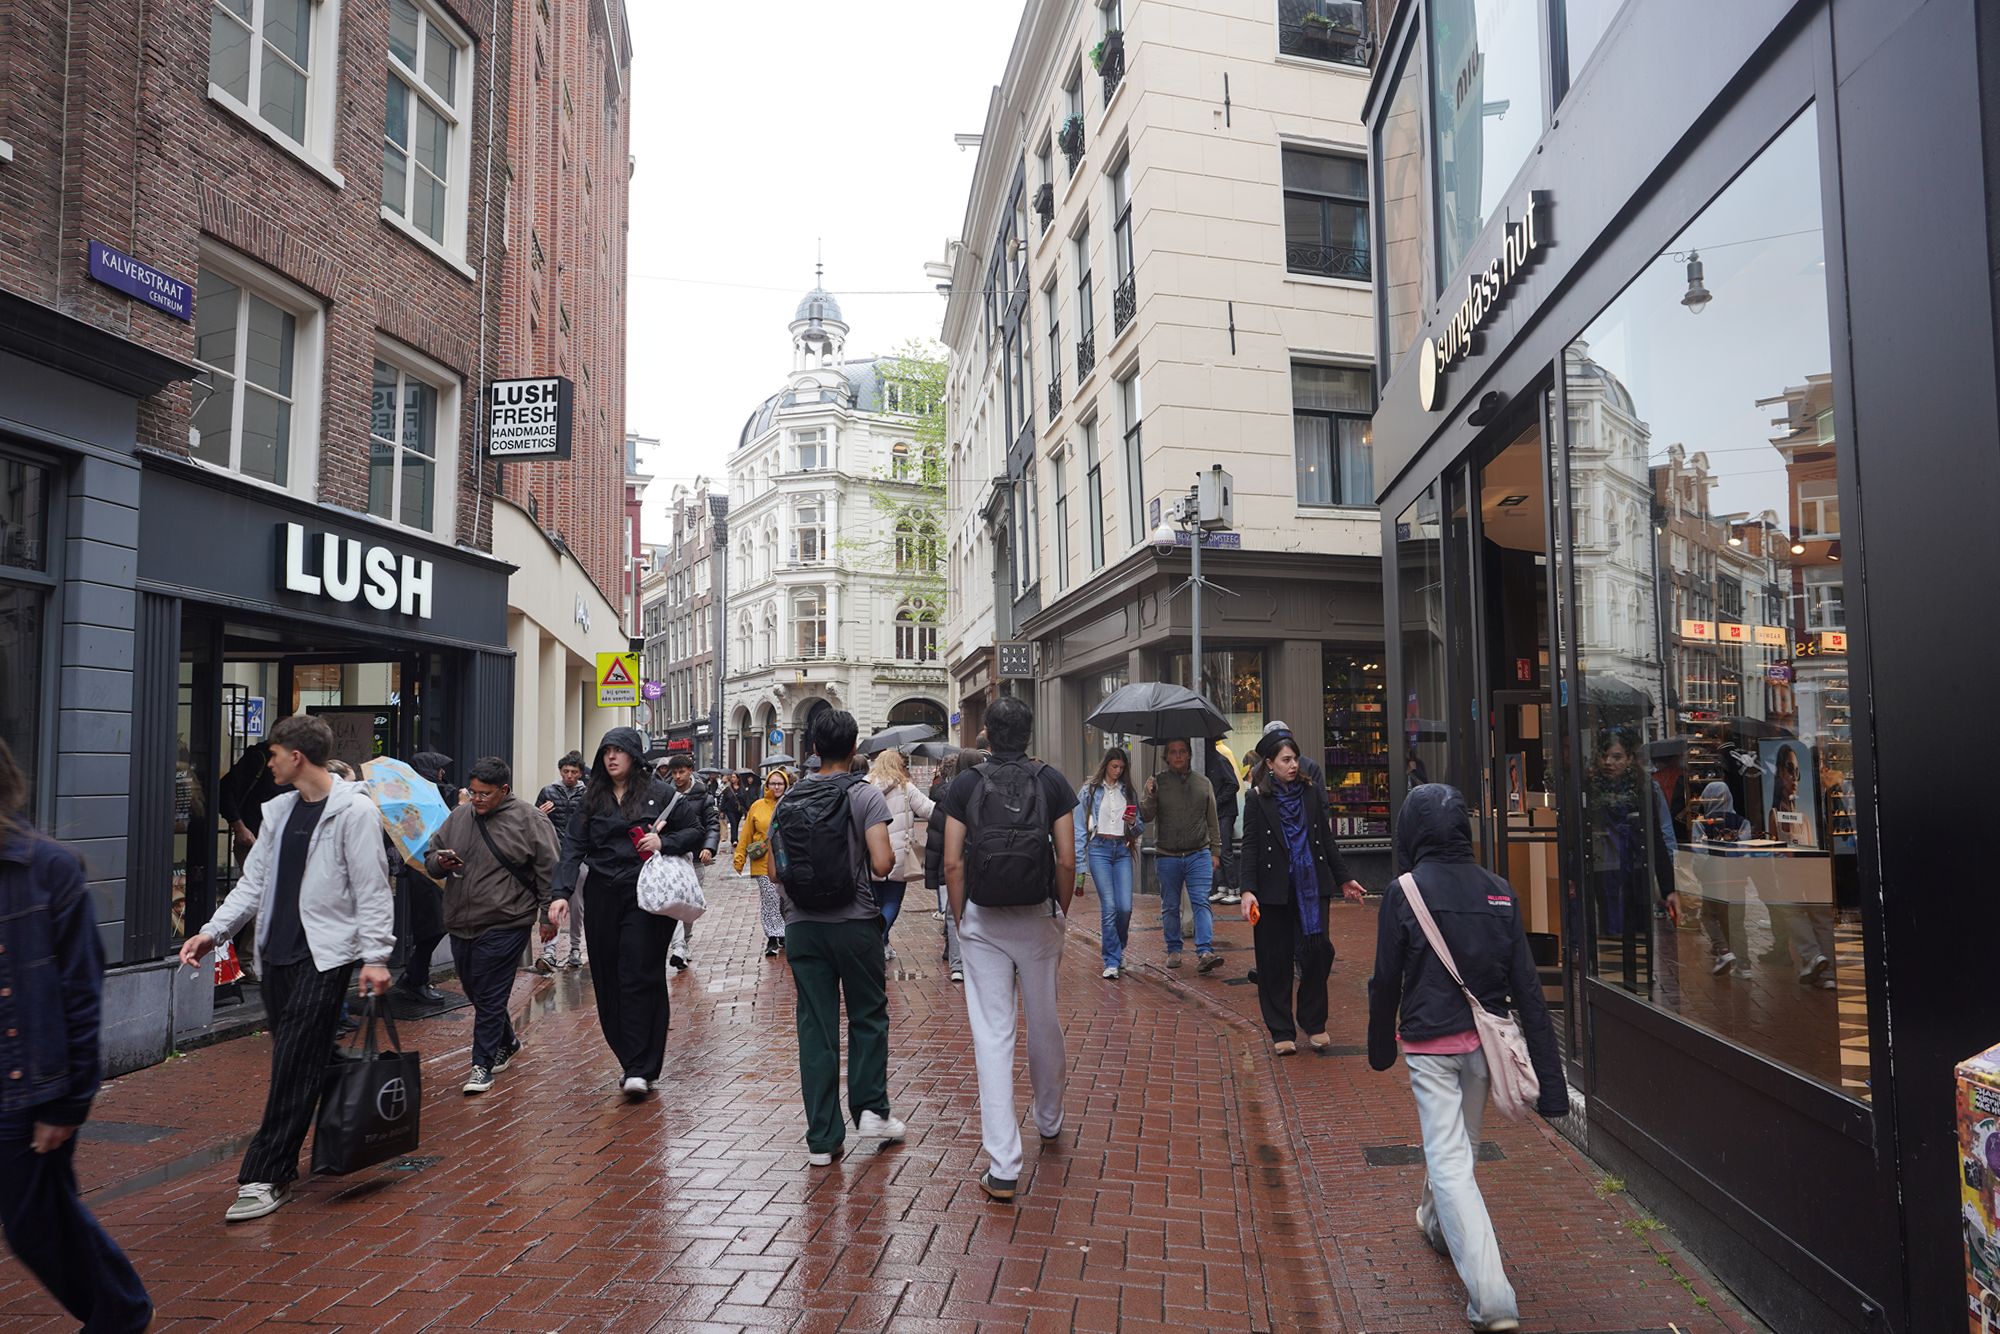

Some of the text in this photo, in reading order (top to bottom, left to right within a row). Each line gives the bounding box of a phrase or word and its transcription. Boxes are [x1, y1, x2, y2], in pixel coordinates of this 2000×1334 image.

[101, 249, 184, 300] KALVERSTRAAT
[1436, 190, 1538, 374] sunglass hut
[148, 290, 183, 313] CENTRUM
[493, 383, 558, 406] LUSH
[492, 405, 557, 426] FRESH
[491, 424, 557, 439] HANDMADE
[491, 437, 556, 451] COSMETICS
[286, 521, 433, 620] LUSH
